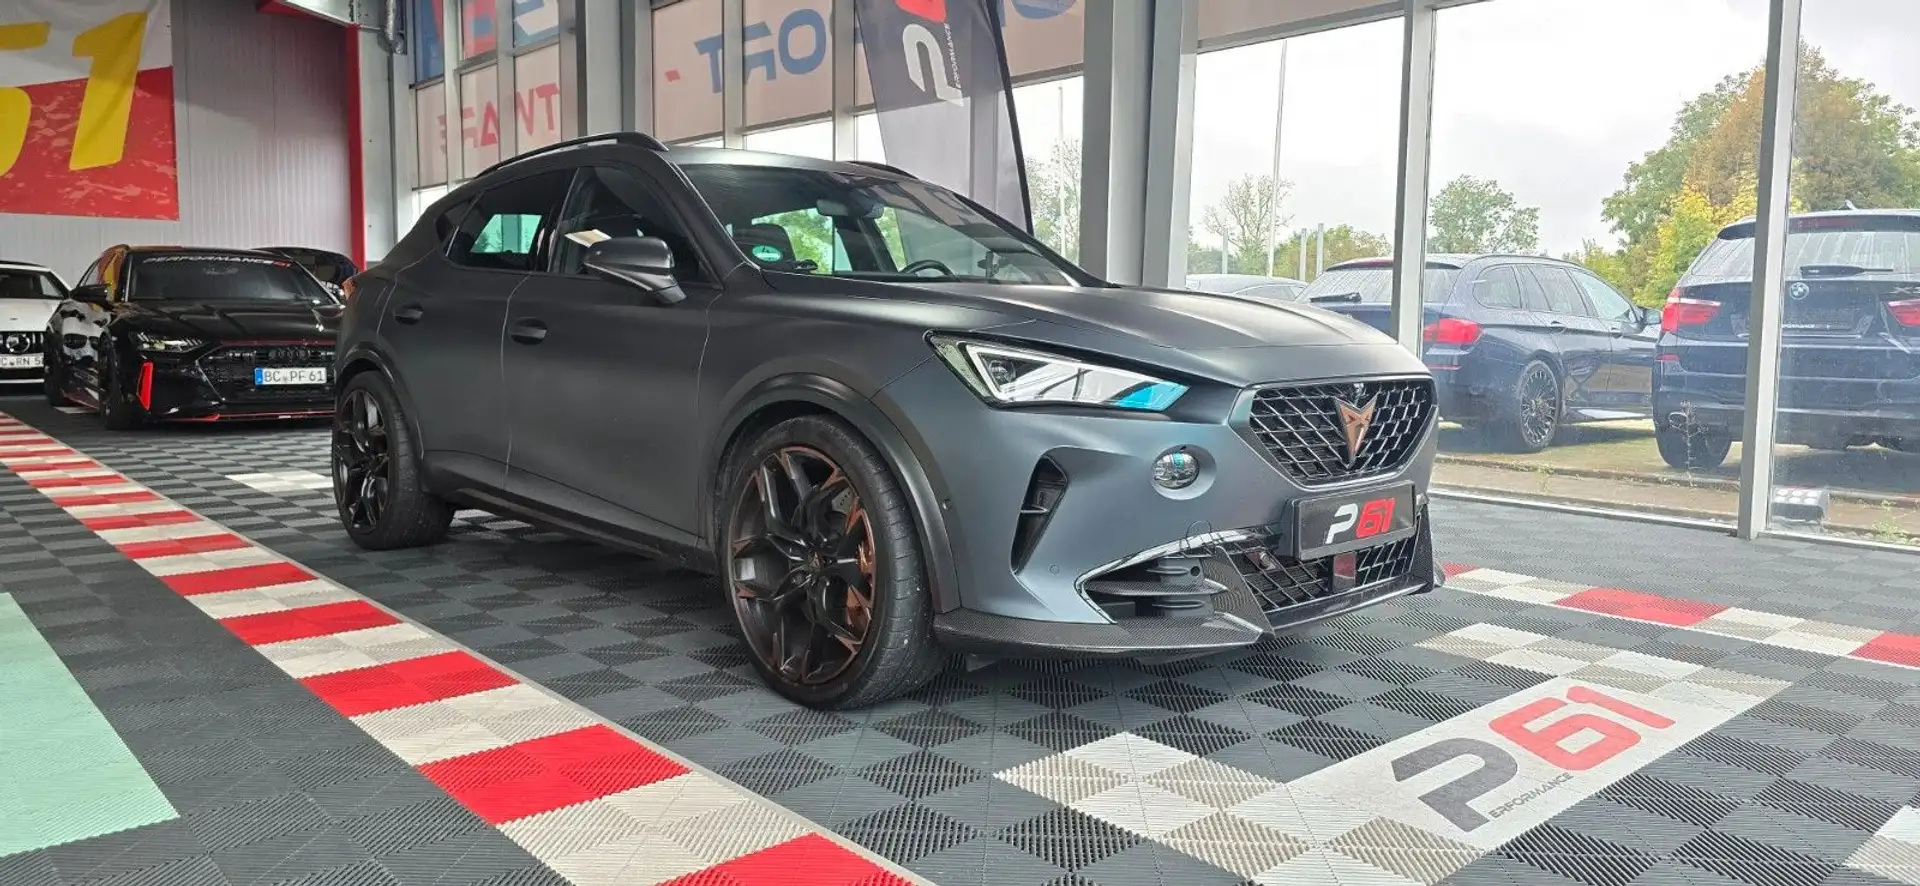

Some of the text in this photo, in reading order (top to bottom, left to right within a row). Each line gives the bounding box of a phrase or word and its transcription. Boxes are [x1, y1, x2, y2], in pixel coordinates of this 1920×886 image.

[264, 370, 324, 382] BC PF 61
[1324, 498, 1396, 545] P61
[1391, 685, 1677, 833] P61
[1488, 772, 1575, 820] ERFORMANCE
